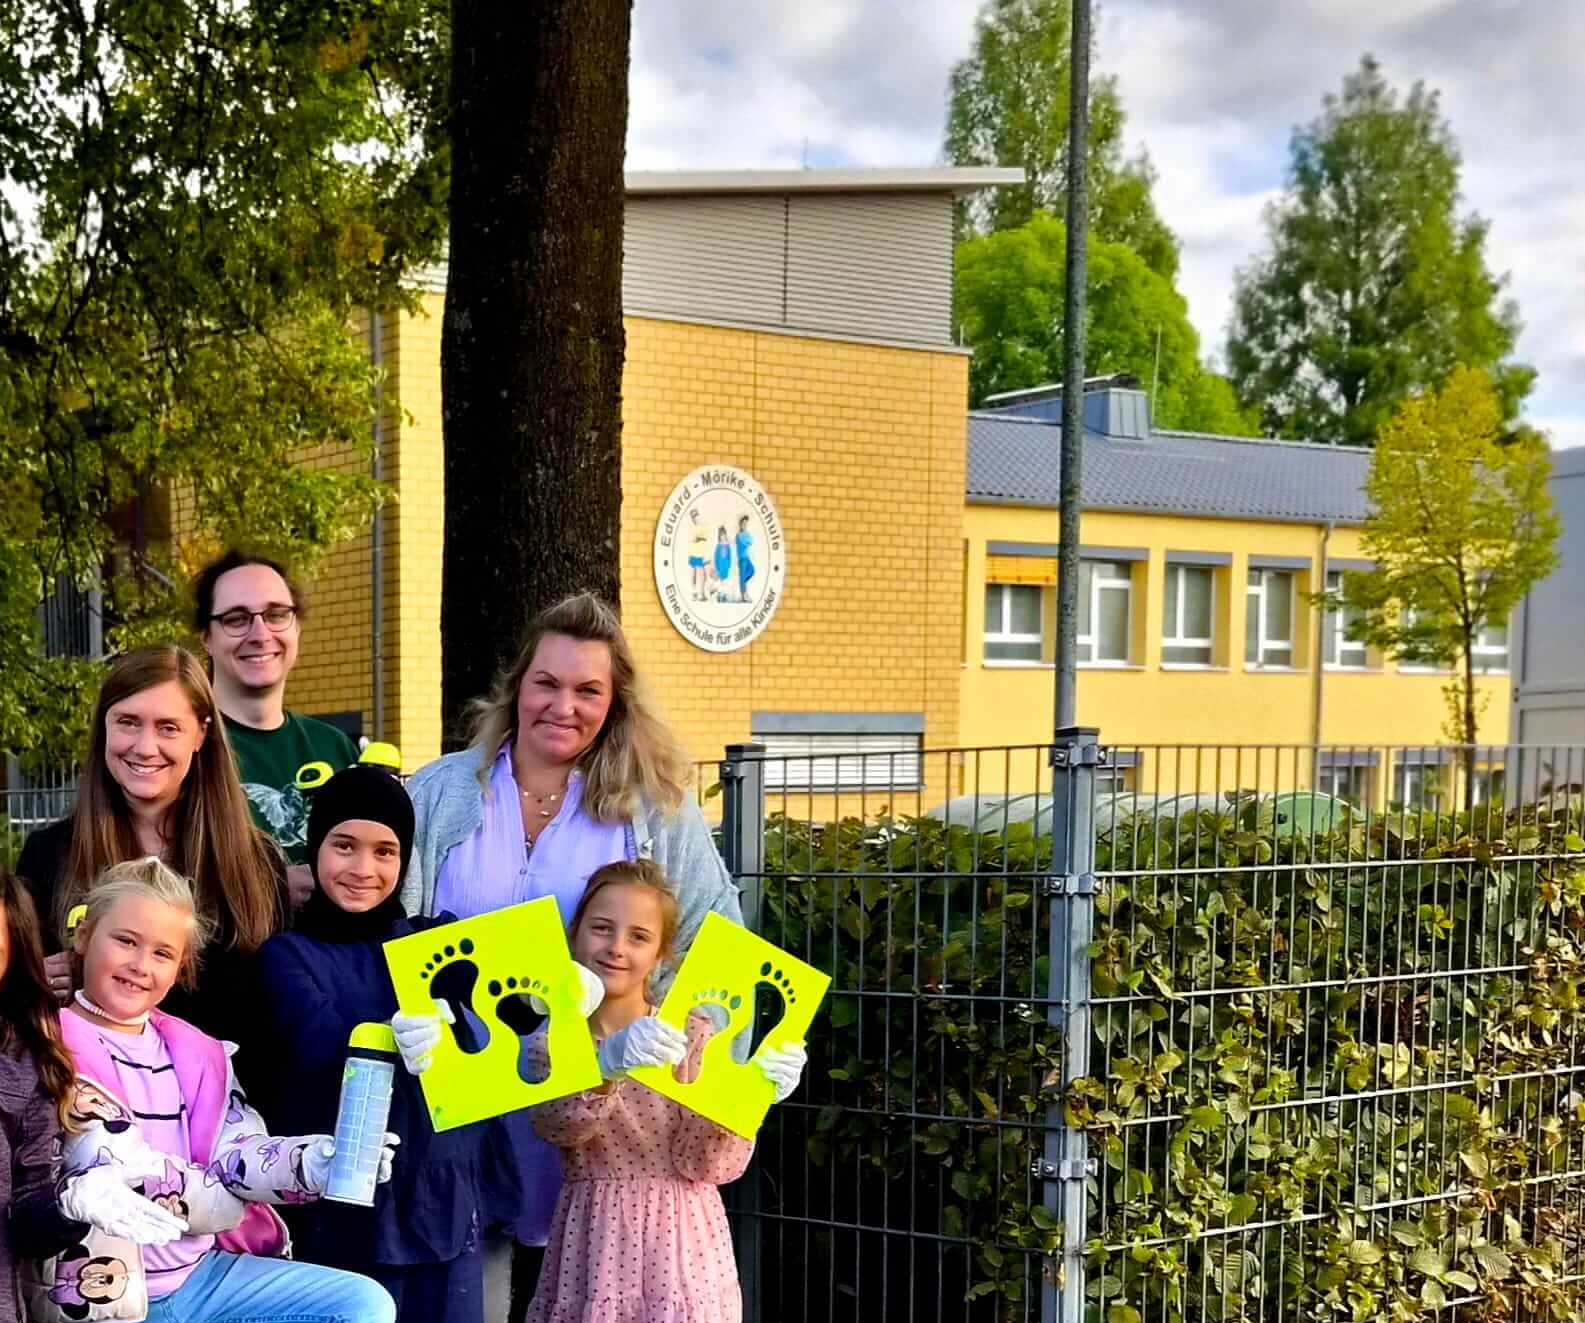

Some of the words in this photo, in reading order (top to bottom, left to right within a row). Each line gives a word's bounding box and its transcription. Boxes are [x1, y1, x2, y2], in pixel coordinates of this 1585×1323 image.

[661, 488, 691, 548] Eduard
[701, 470, 745, 489] Mörike
[754, 493, 780, 551] Schule
[665, 584, 681, 616] Eine
[680, 613, 714, 644] Schule
[716, 632, 732, 645] für
[734, 627, 753, 642] alle
[751, 589, 776, 629] Kinder
